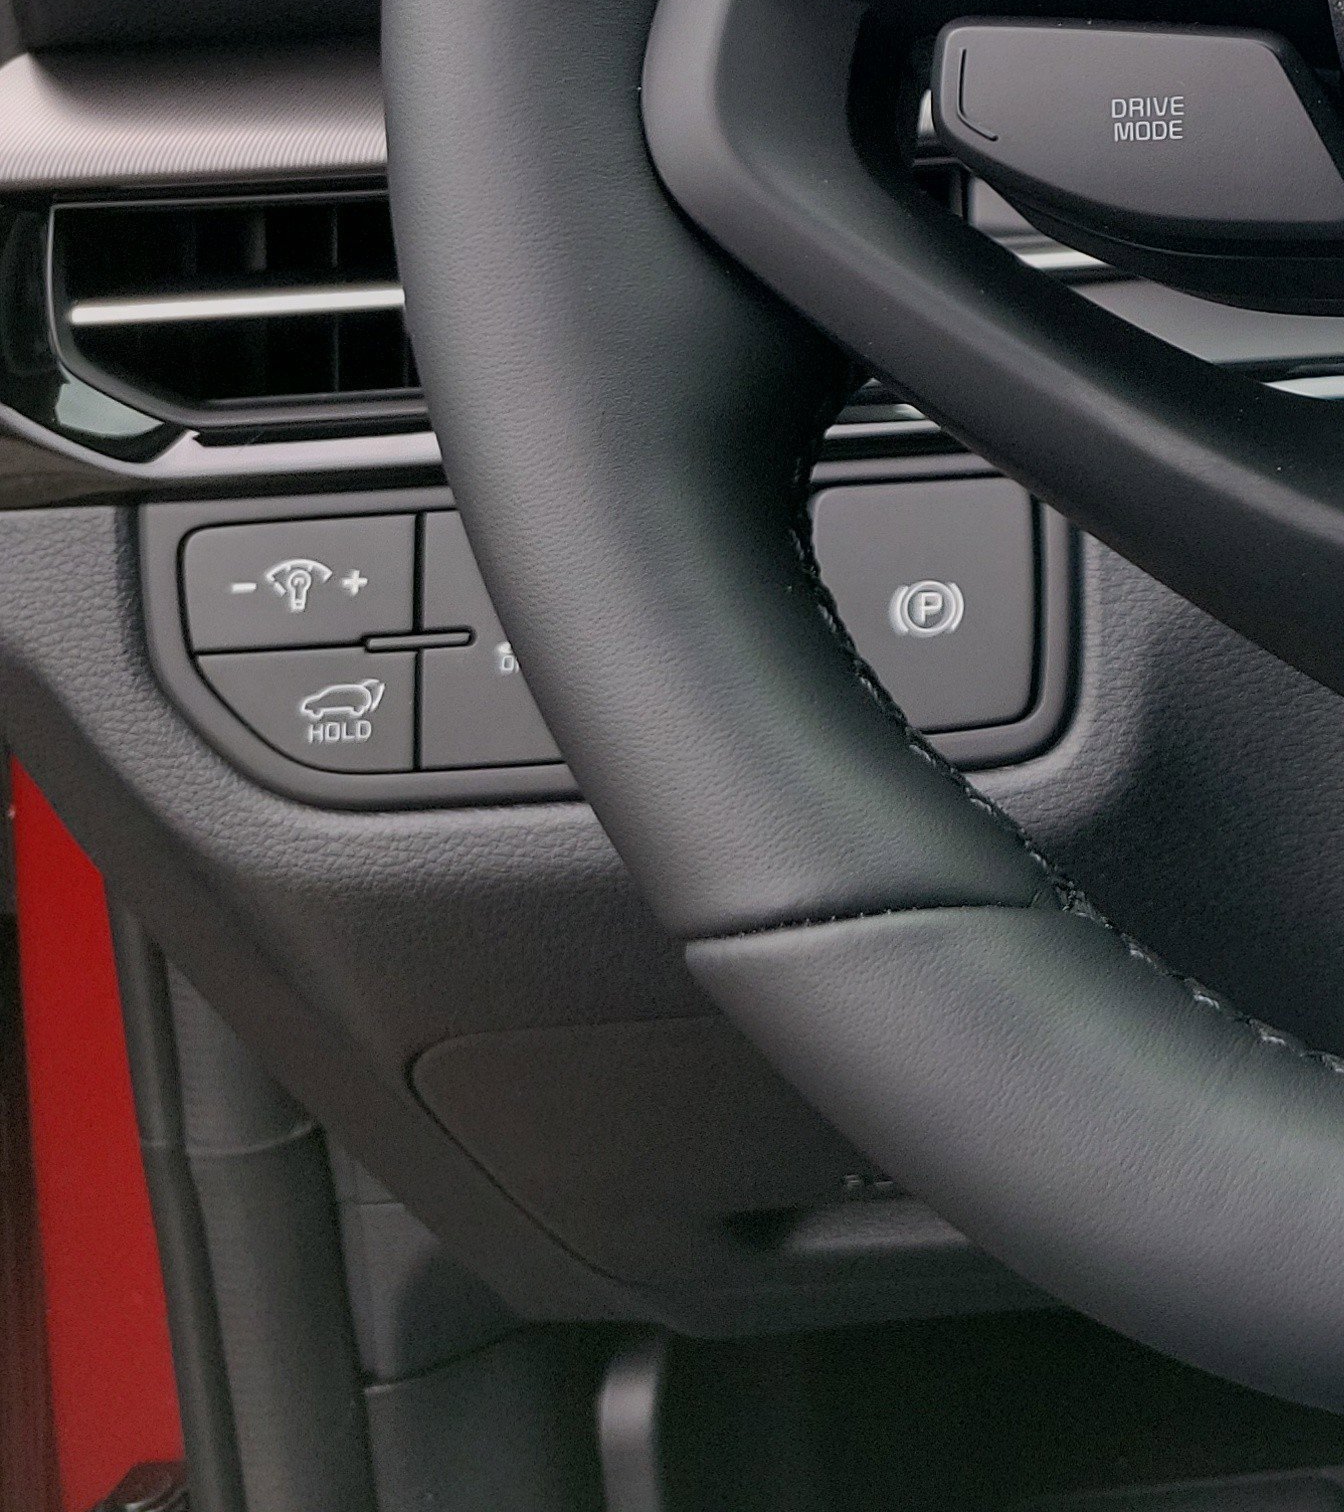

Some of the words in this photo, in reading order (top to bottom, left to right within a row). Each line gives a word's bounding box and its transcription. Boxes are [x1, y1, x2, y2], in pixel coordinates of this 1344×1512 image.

[1111, 96, 1185, 119] DRIVE
[1114, 120, 1184, 142] MODE
[308, 719, 372, 744] HOLD
